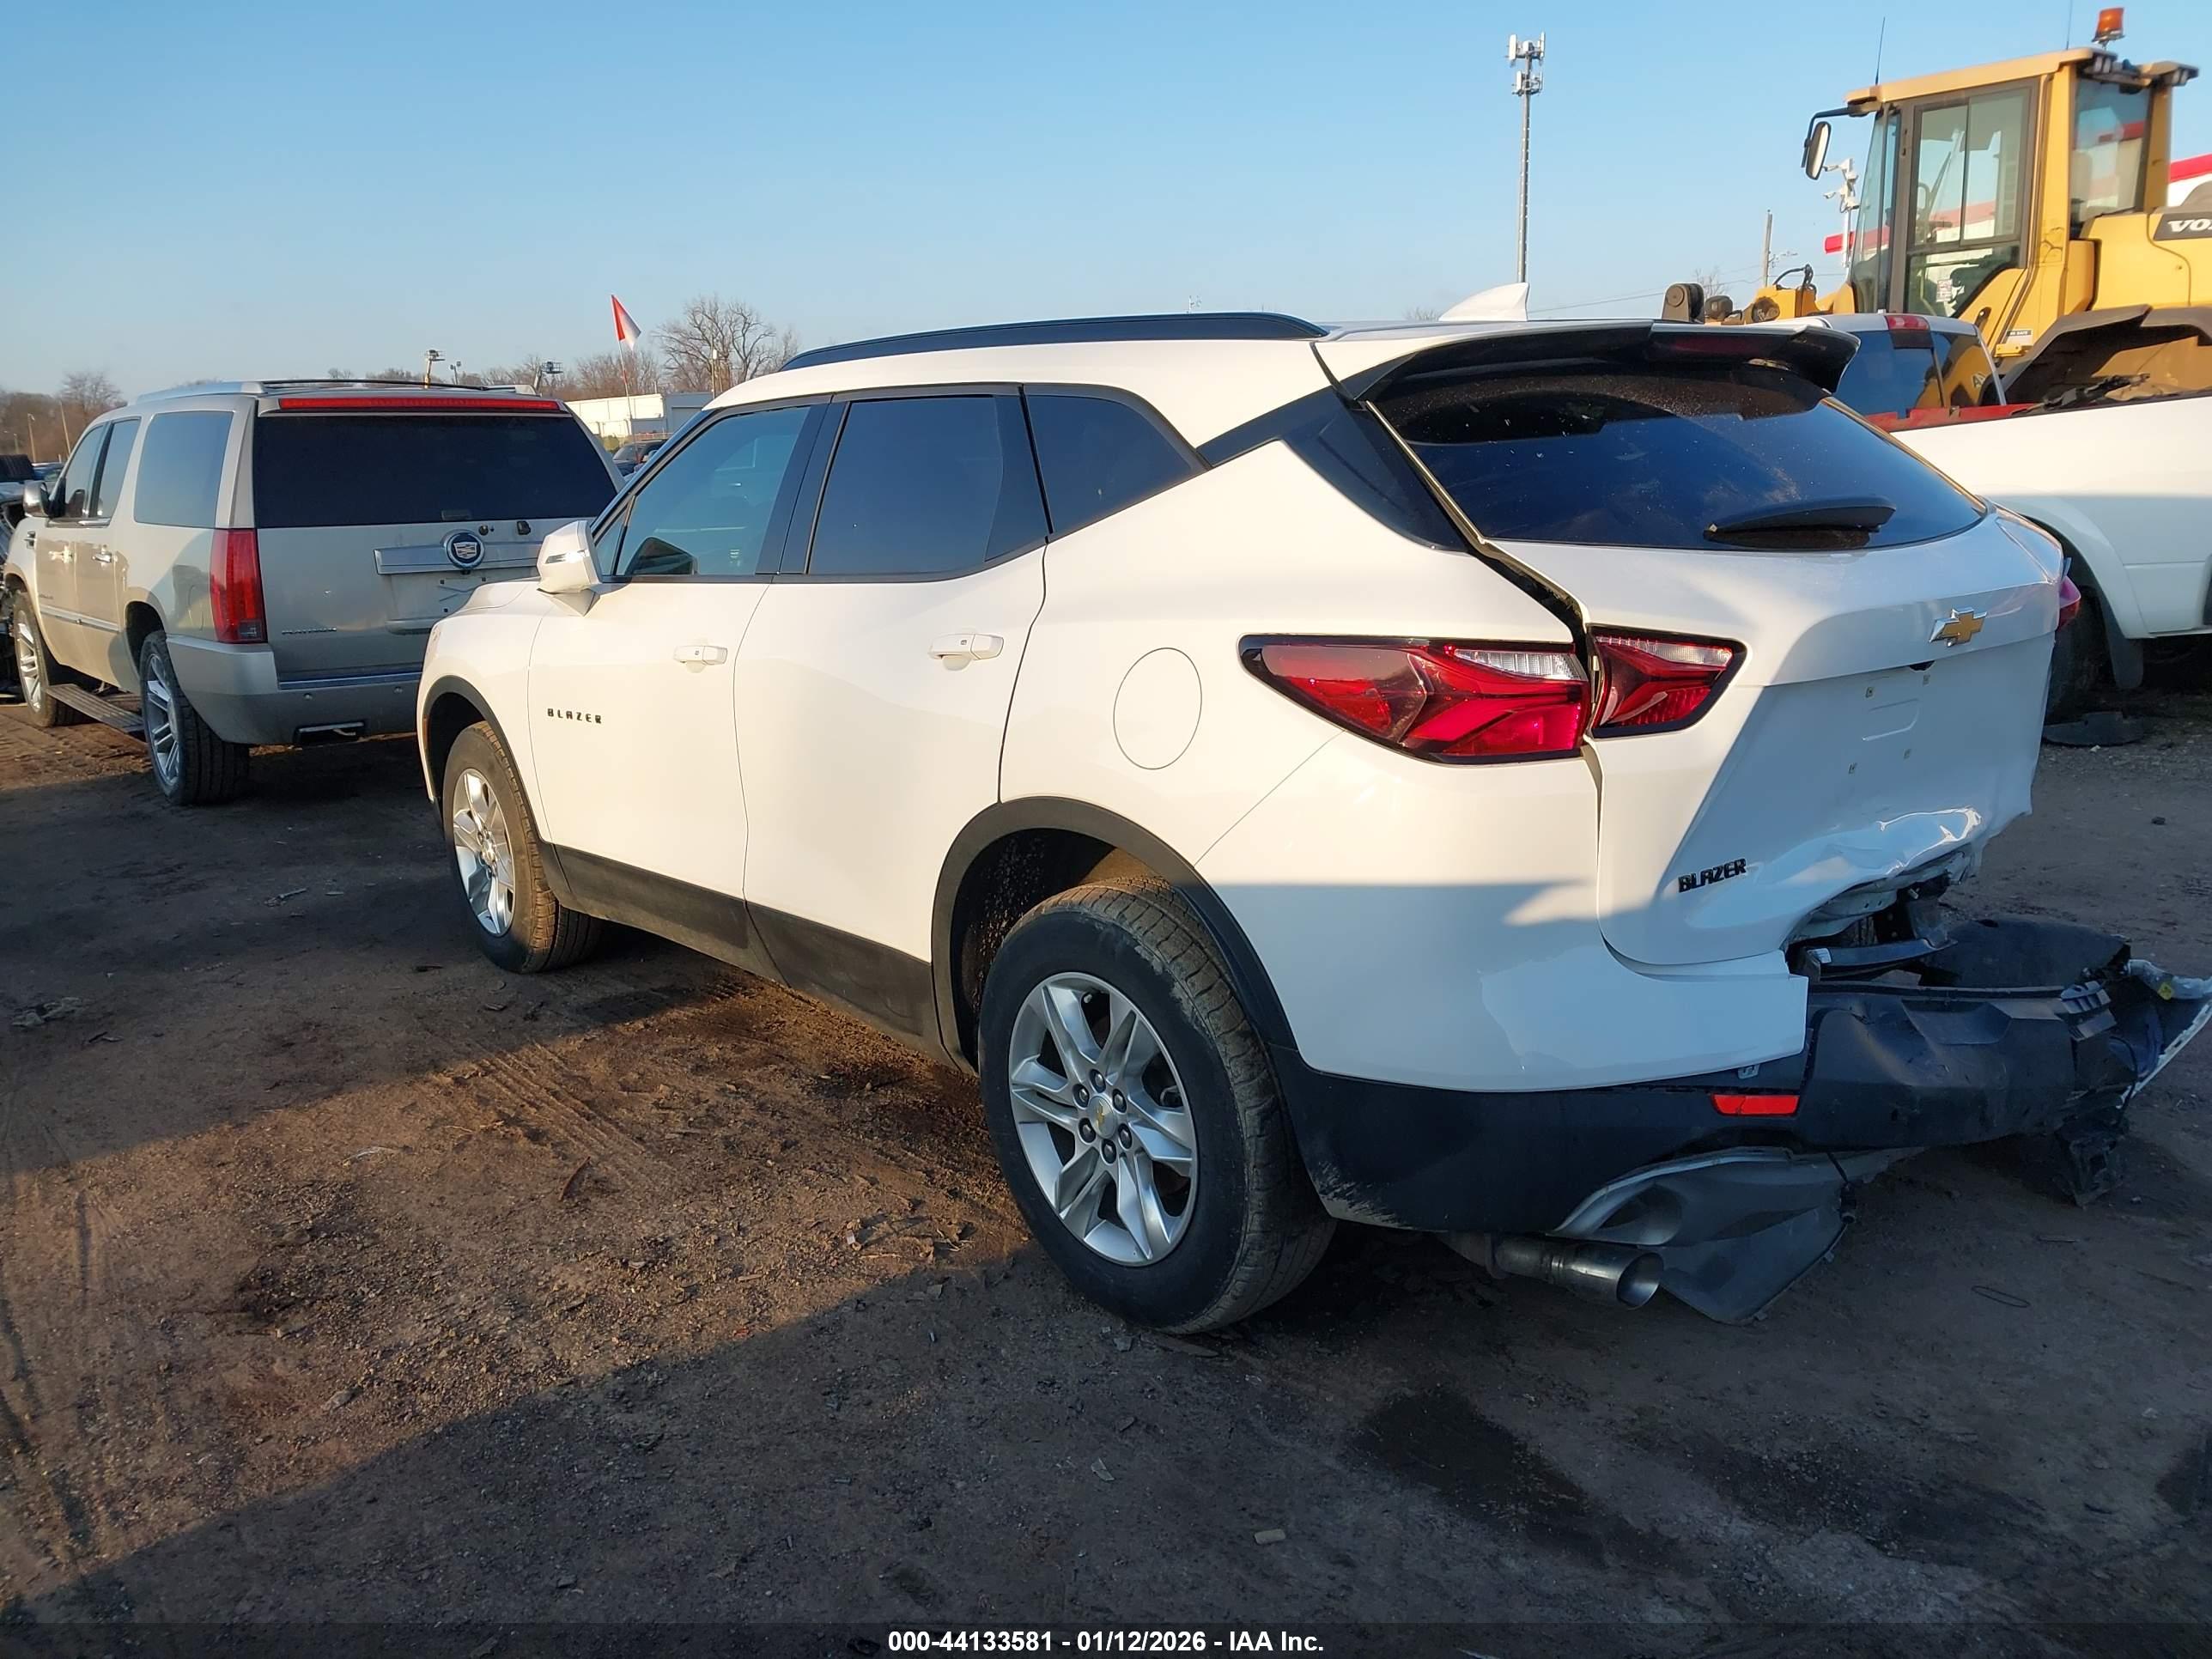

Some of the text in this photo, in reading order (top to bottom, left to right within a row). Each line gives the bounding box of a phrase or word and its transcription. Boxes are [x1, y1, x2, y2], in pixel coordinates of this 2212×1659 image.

[2167, 218, 2212, 232] VO
[547, 708, 602, 724] BLAZER
[1678, 858, 1747, 893] BLAZER
